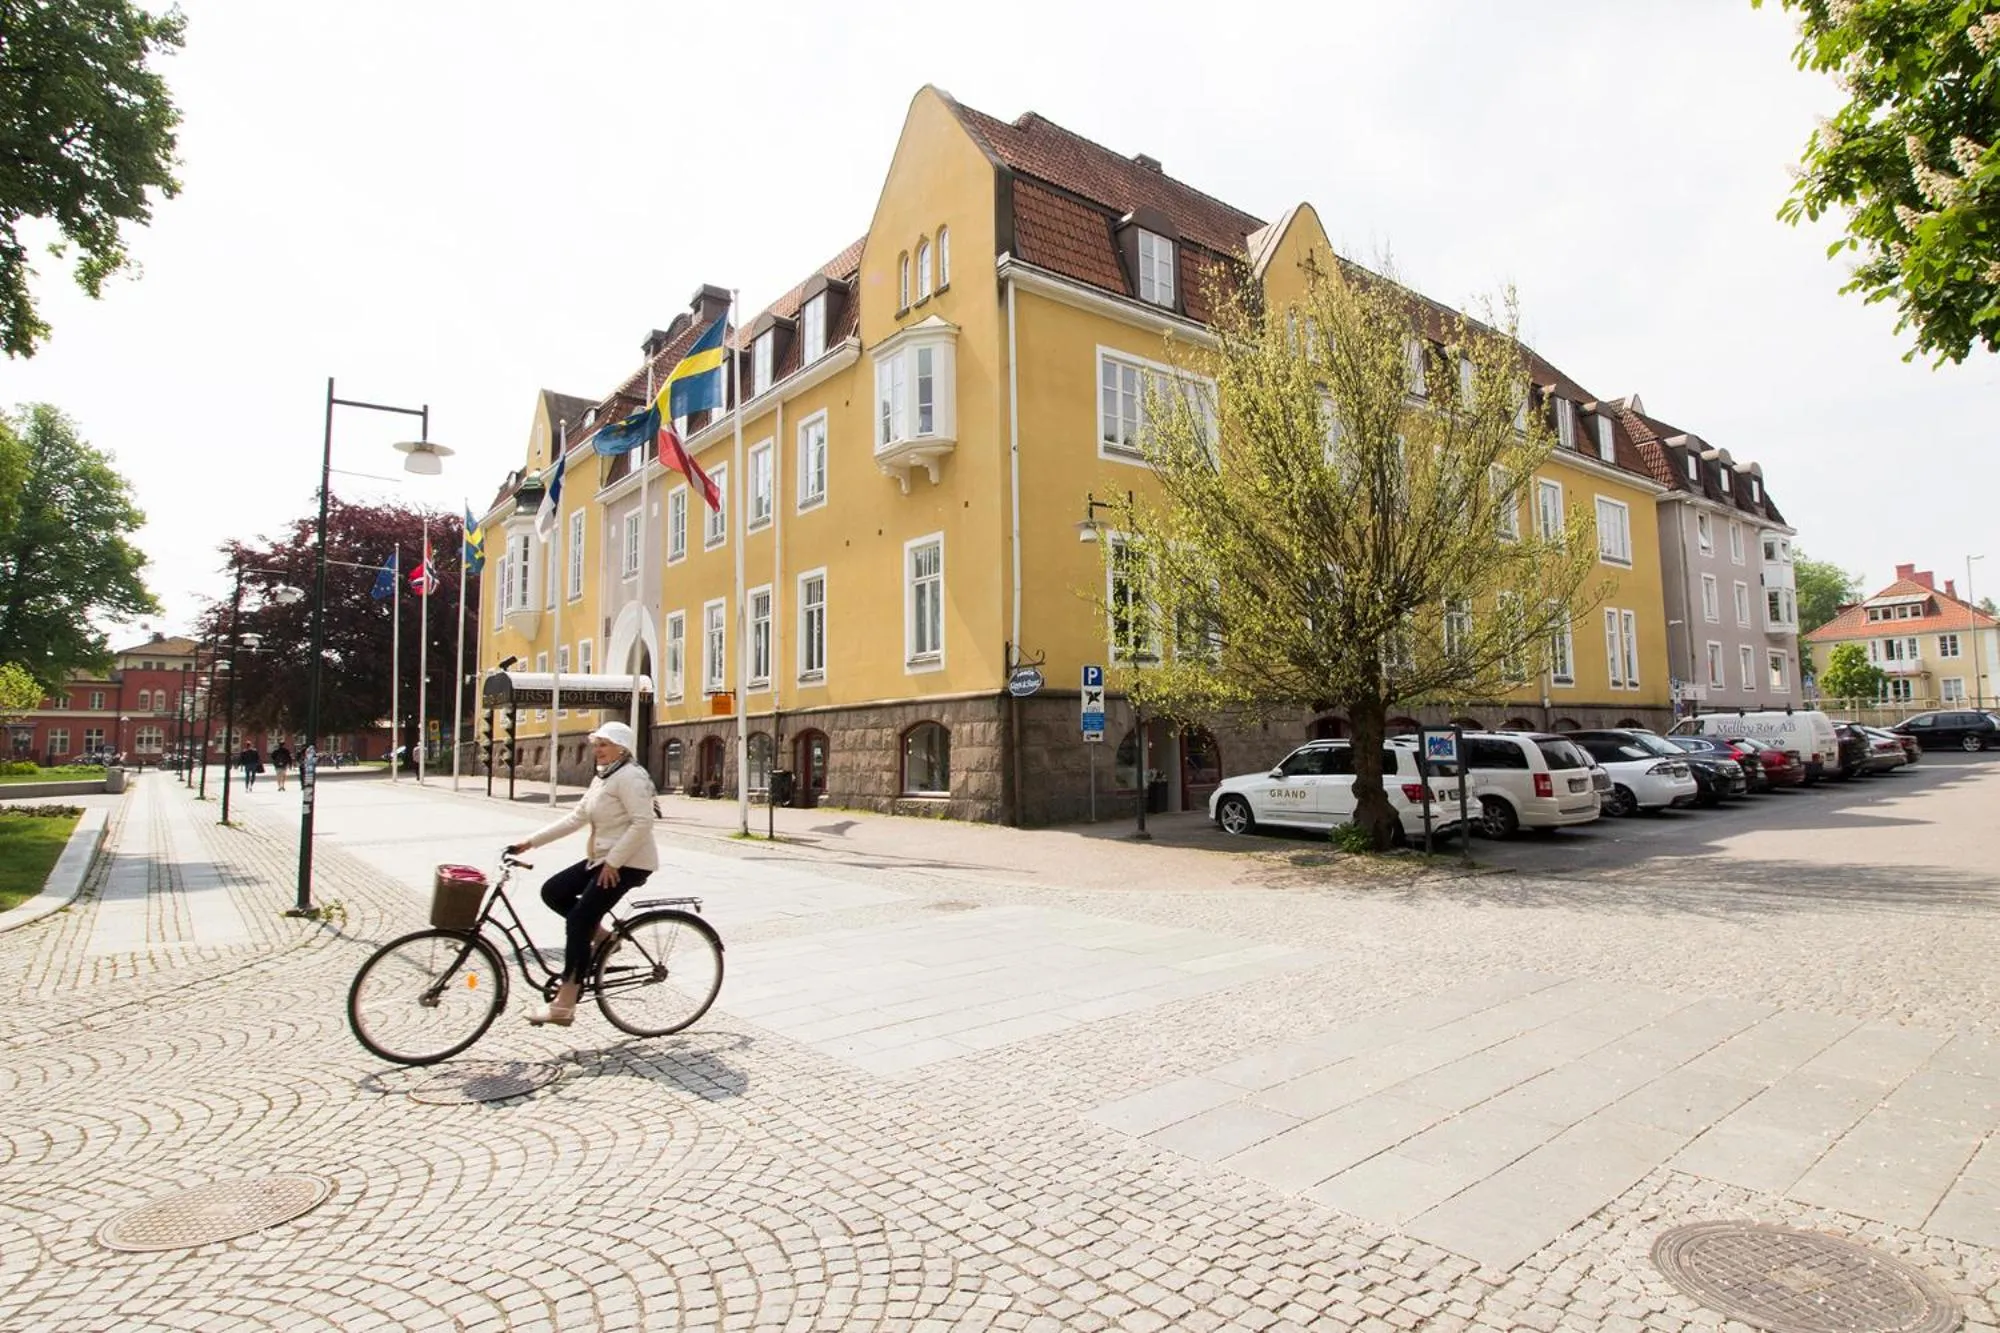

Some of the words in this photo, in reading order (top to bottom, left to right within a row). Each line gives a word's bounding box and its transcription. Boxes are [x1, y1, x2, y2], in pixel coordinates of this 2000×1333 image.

[1087, 667, 1098, 685] P
[513, 689, 552, 702] FIRST
[558, 690, 599, 703] HOTEL
[1270, 788, 1307, 800] GRAND
